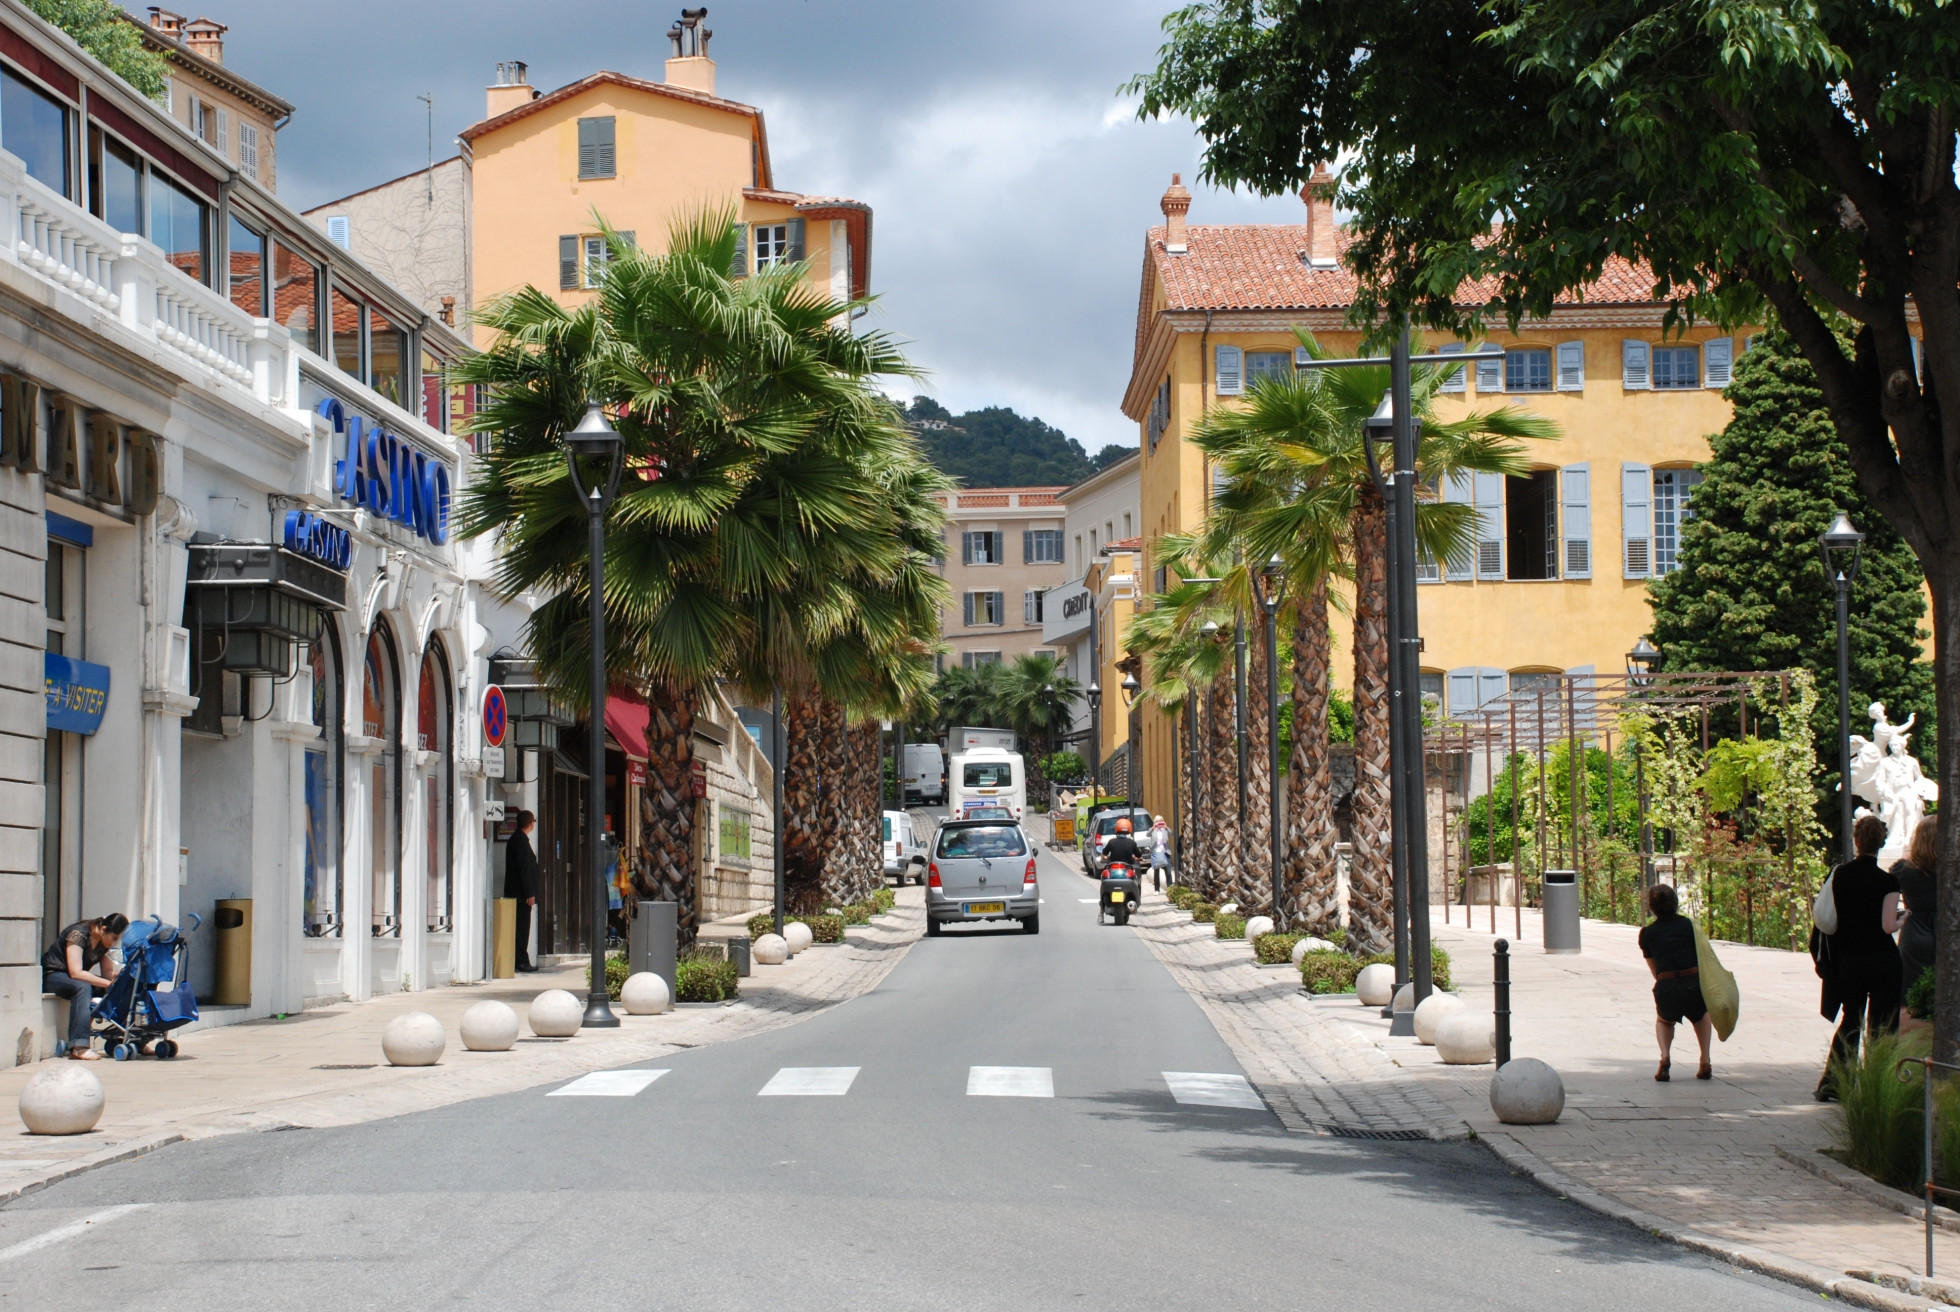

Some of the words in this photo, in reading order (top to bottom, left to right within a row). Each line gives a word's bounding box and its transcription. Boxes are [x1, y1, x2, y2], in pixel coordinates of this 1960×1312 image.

[318, 398, 450, 546] CASINO
[284, 510, 352, 571] CASINO
[65, 684, 105, 715] VISITER
